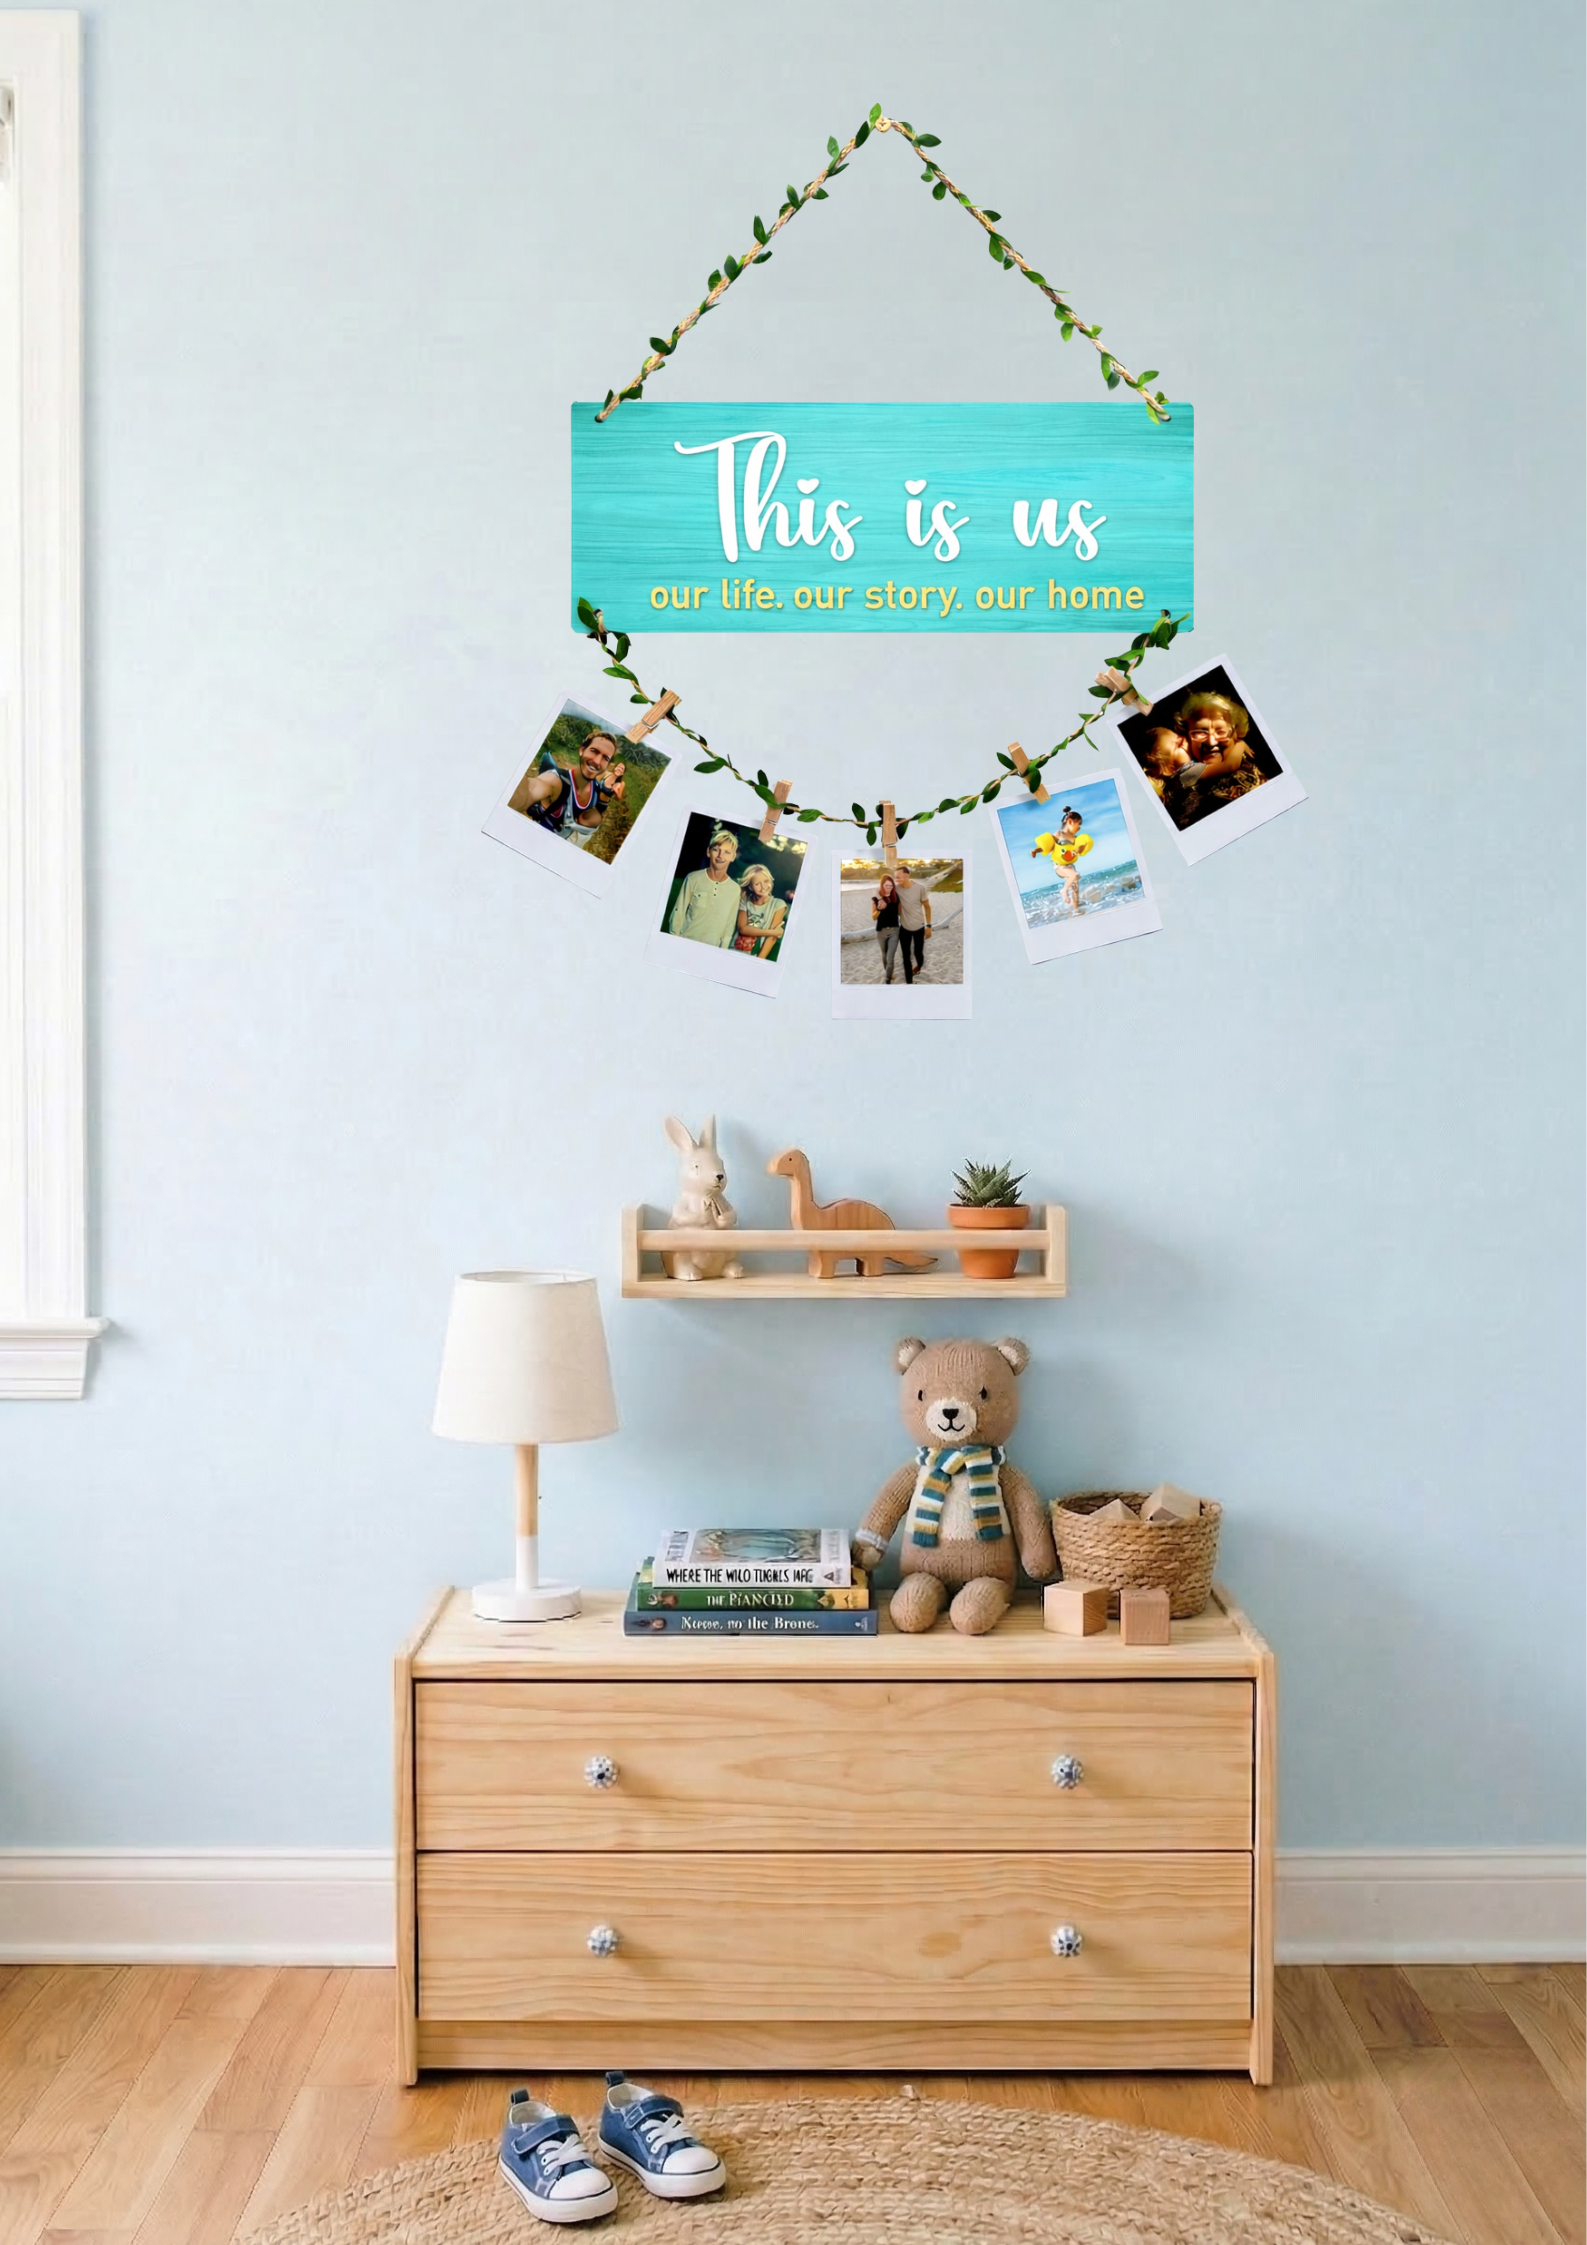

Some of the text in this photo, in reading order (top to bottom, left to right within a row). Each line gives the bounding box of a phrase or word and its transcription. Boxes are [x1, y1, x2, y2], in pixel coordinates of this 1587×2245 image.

[674, 431, 1107, 563] This is us
[650, 578, 1145, 618] our life. our story. our home
[666, 1568, 701, 1583] WHERE
[703, 1568, 723, 1583] THE
